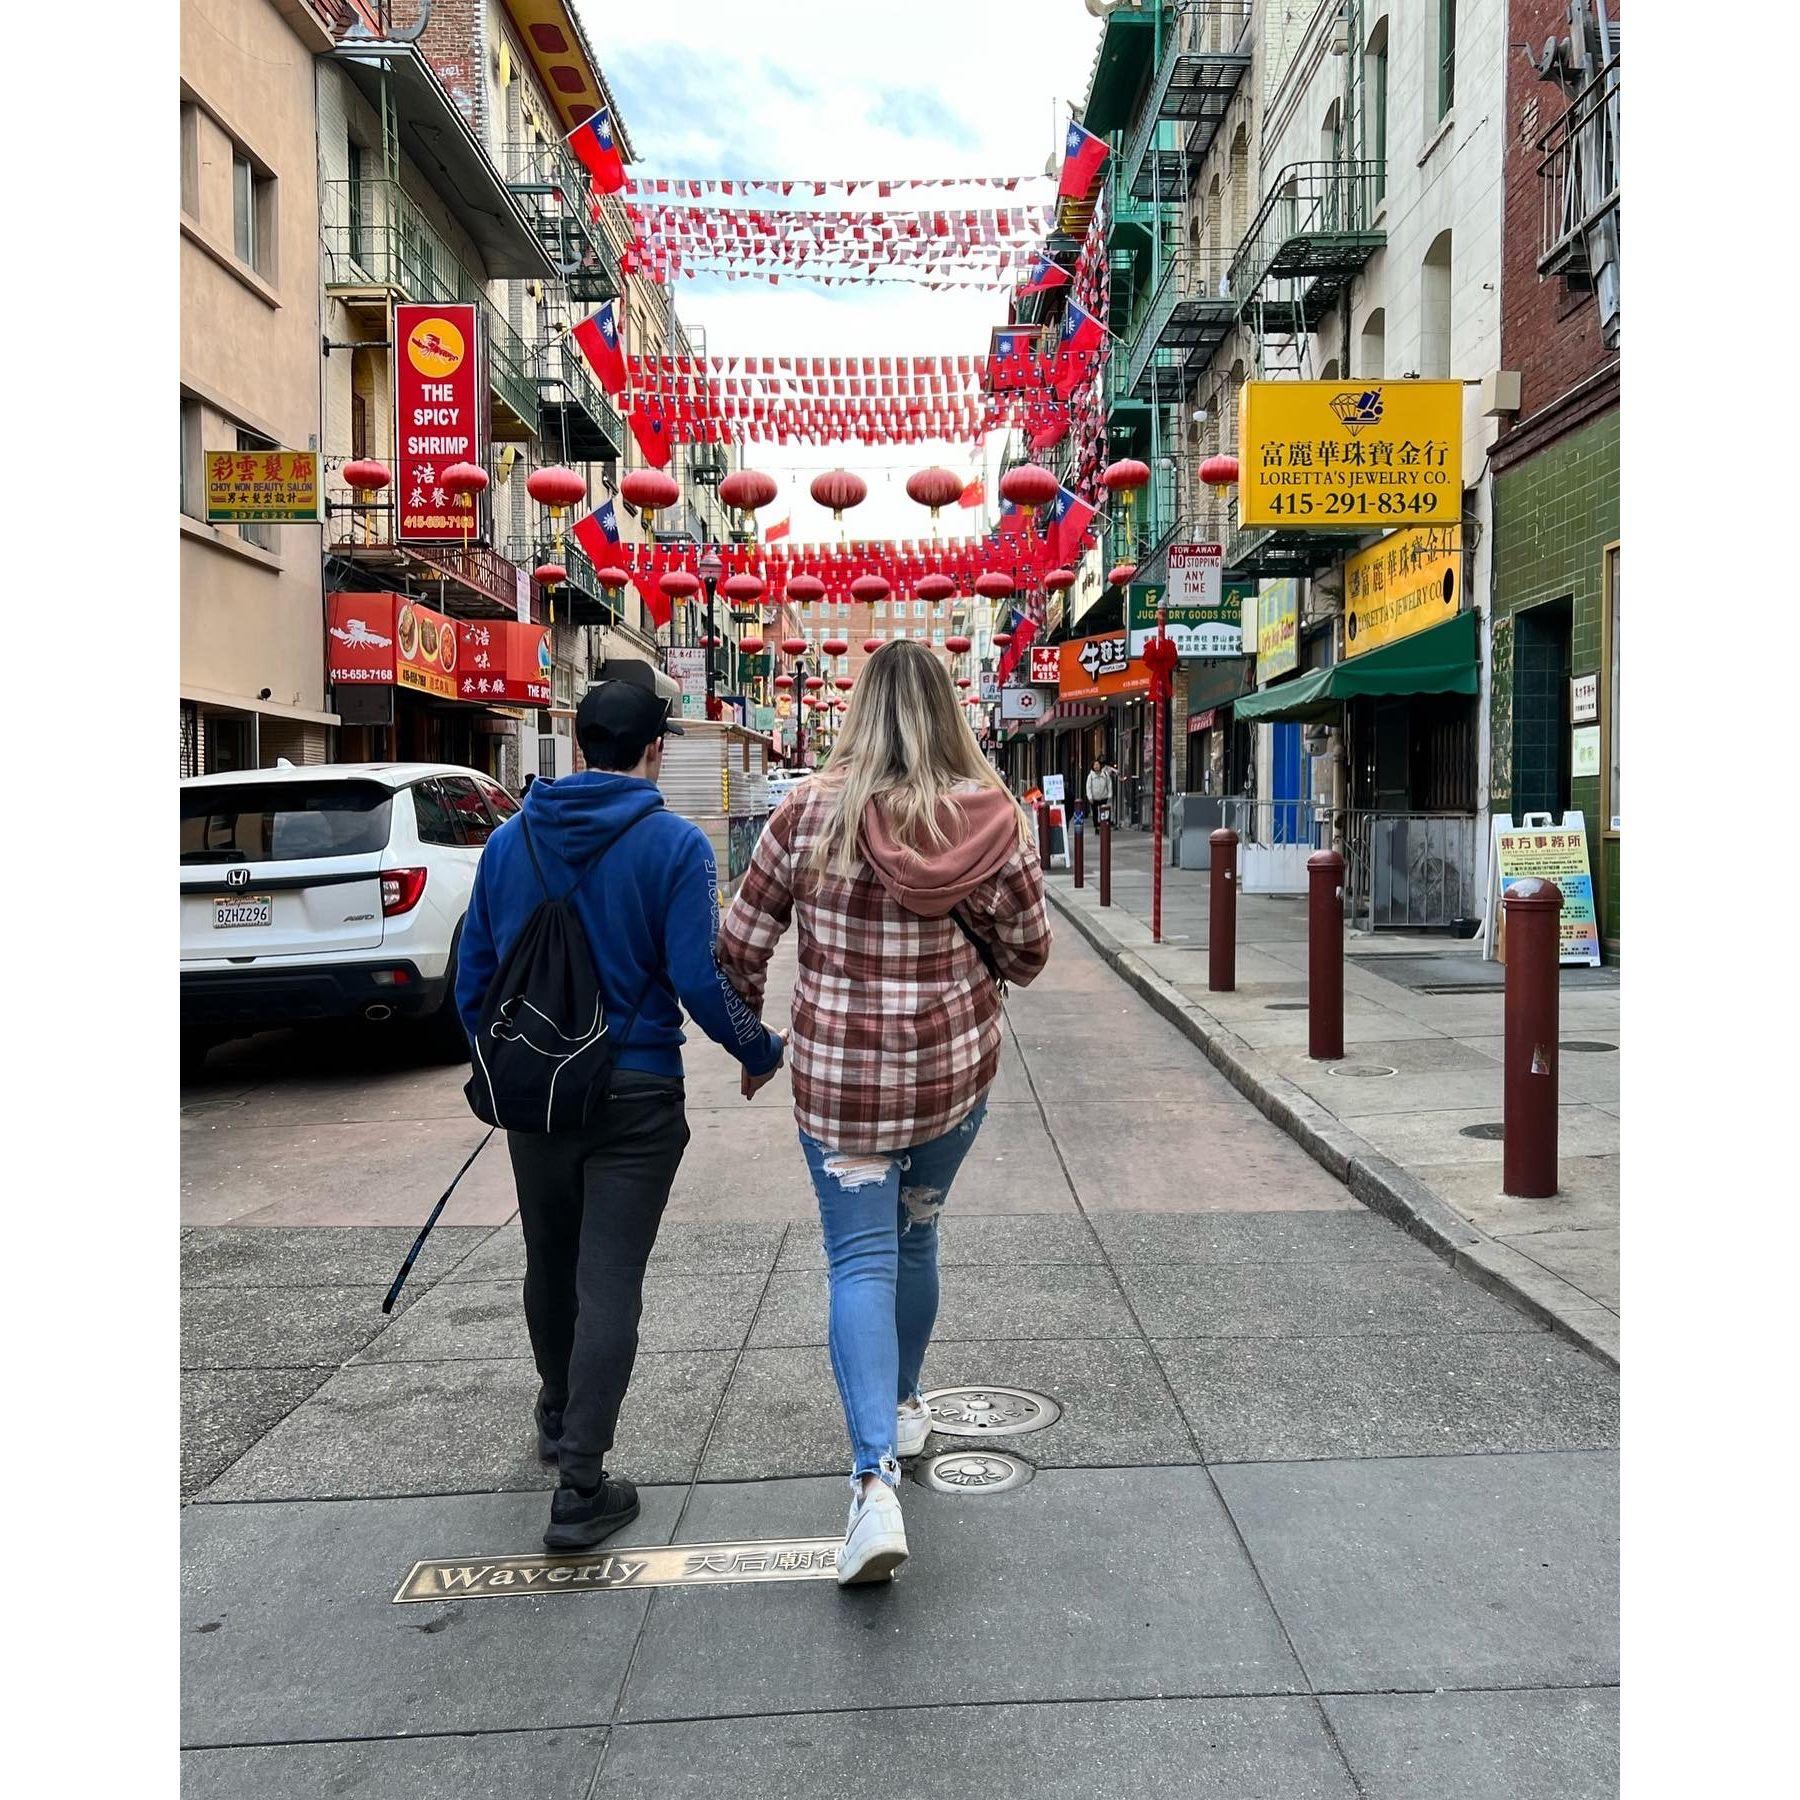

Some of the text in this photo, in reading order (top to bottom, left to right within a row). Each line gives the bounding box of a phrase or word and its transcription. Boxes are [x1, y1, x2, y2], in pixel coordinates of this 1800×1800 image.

[421, 384, 454, 402] THE
[413, 408, 460, 426] SPICY
[408, 436, 469, 455] SHRIMP
[1260, 440, 1449, 467] 富麗華珠寶金行
[211, 454, 312, 482] 彩雲髮廊
[210, 483, 312, 492] CHOY WON BEAUTY SALON
[1260, 471, 1450, 488] LORETTA'S JEWELRY CO.
[1269, 493, 1438, 515] 415-291-8349
[1170, 554, 1220, 568] NO STOPPING
[1184, 571, 1205, 580] ANY
[1184, 583, 1206, 593] TIME
[1168, 610, 1186, 620] DRY
[1189, 610, 1218, 620] GOODS
[331, 668, 393, 680] 415-658-7168
[461, 677, 505, 693] 茶餐廳
[527, 684, 540, 698] THE
[1501, 834, 1581, 850] 東方事務所
[218, 907, 267, 922] 8ZHZ296
[438, 1557, 648, 1590] Waverly
